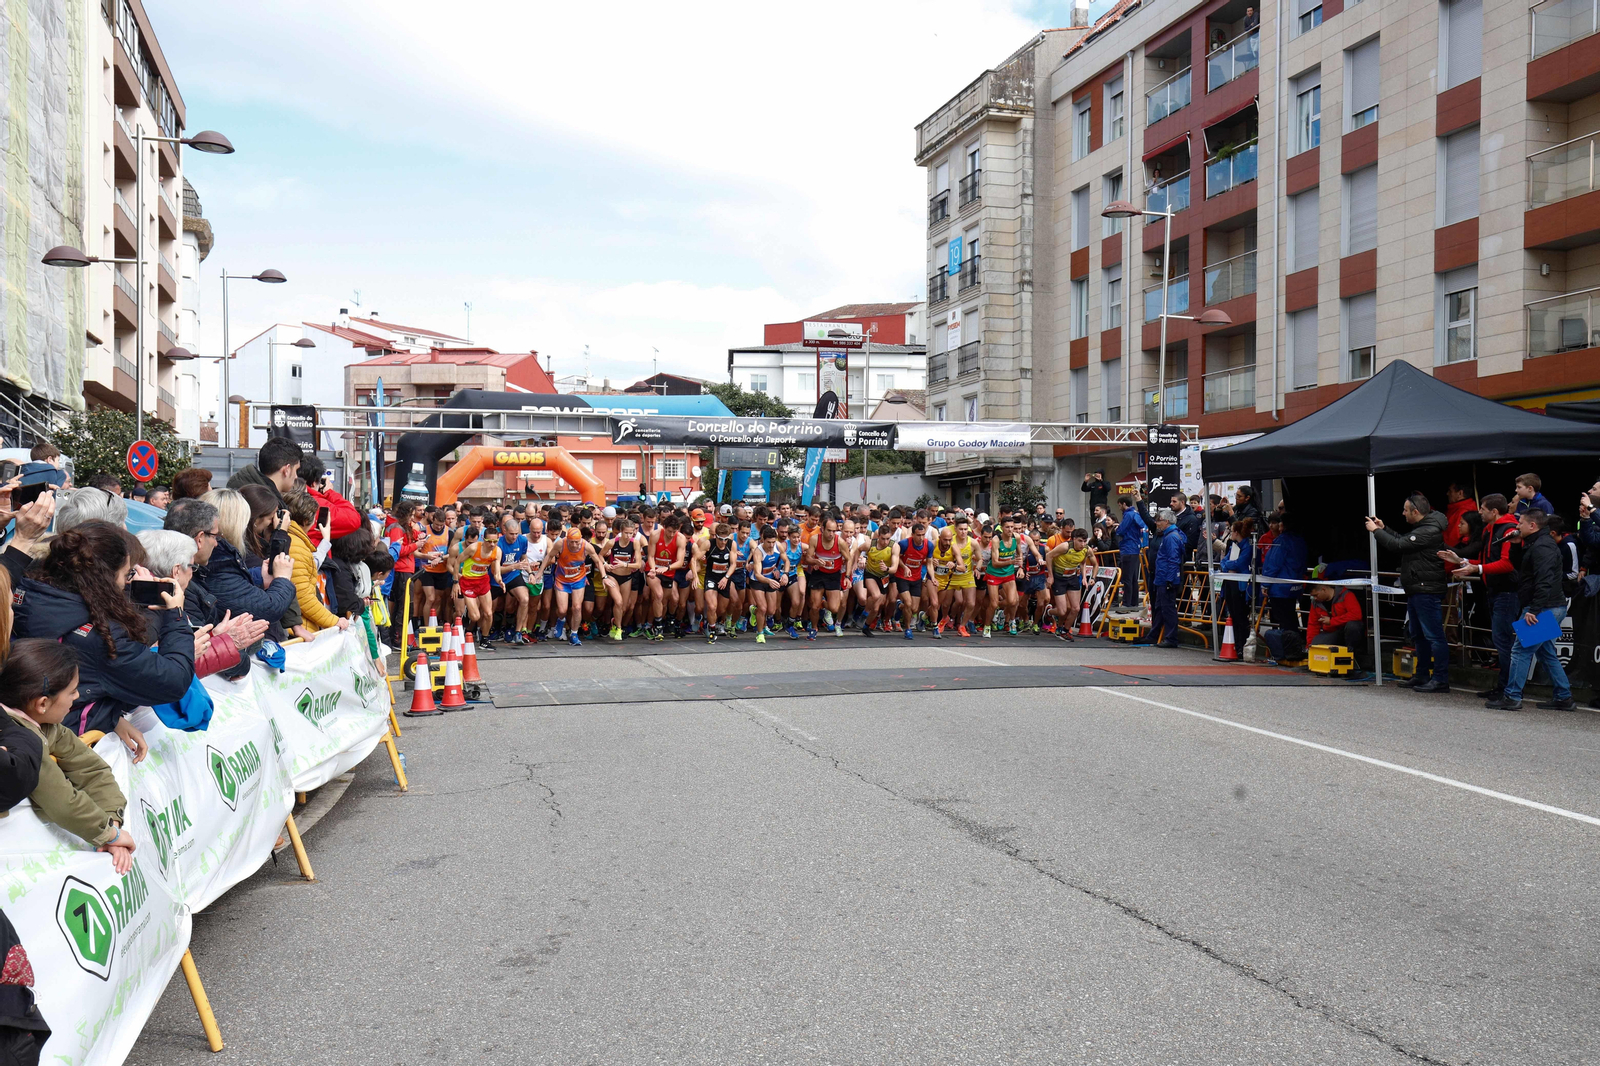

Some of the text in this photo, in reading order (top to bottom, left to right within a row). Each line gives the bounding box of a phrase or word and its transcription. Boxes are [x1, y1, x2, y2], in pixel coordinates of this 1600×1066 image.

[287, 420, 314, 428] Porriño
[687, 419, 823, 435] Concello do Porriño
[709, 434, 797, 446] O Concello do Deporte
[858, 437, 889, 446] Porriño
[926, 438, 1026, 449] Grupo Godoy Maceira
[495, 451, 545, 464] GADIS
[314, 690, 342, 721] RAMA
[227, 740, 262, 786] RAMA
[104, 856, 150, 934] RAMA
